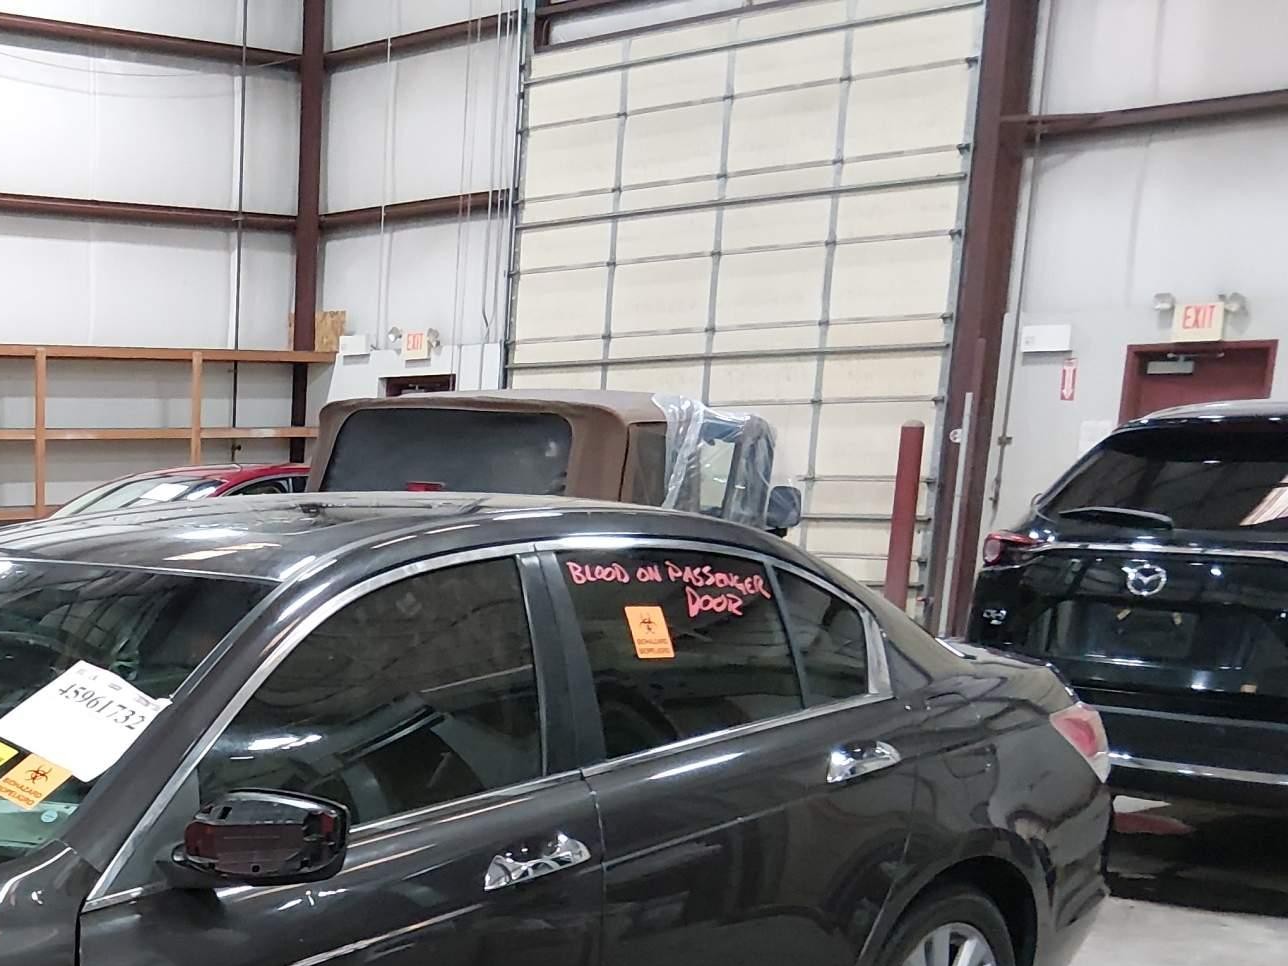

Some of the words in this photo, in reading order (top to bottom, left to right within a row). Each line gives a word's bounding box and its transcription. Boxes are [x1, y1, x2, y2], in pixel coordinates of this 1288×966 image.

[1181, 304, 1217, 330] EXIT
[406, 333, 424, 351] EXIT
[565, 560, 630, 585] BLOOD
[636, 564, 662, 583] ON
[685, 586, 744, 618] DOOR
[57, 683, 147, 730] 45961732
